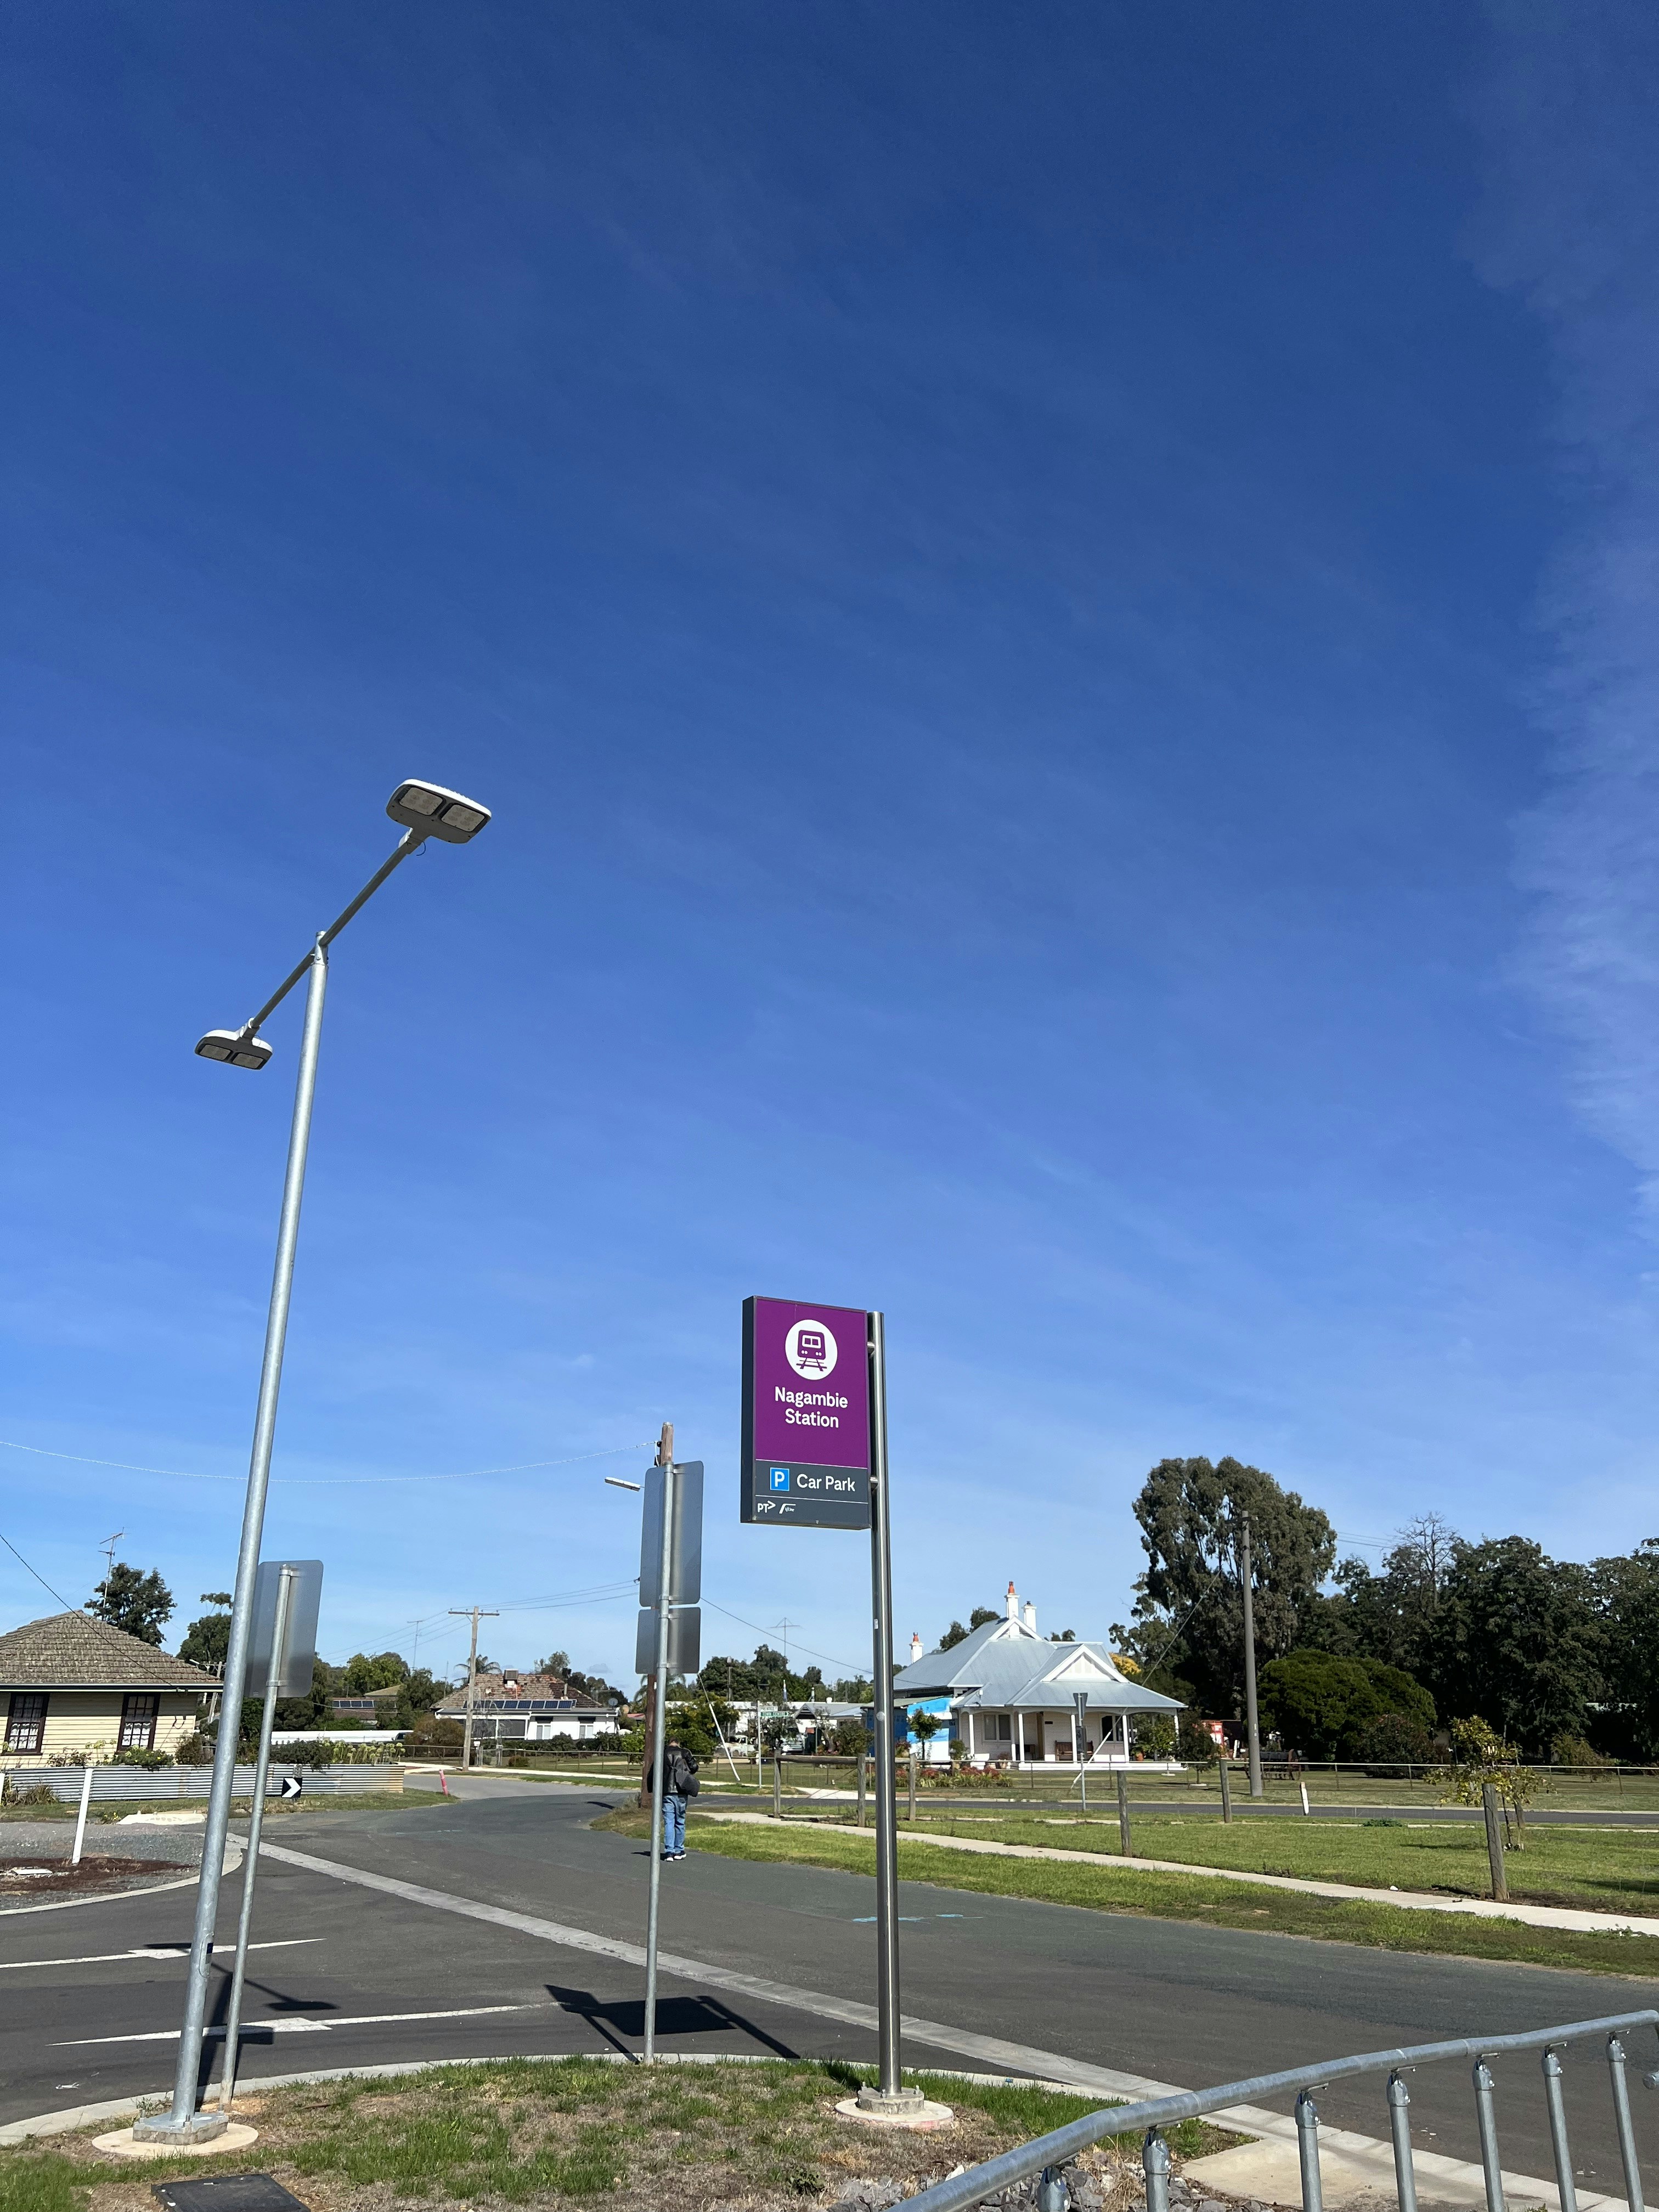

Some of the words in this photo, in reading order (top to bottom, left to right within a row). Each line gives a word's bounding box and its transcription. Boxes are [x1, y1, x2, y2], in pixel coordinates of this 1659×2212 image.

[775, 1386, 848, 1408] Nagambie
[785, 1408, 839, 1428] Station
[774, 1471, 785, 1487] P
[797, 1474, 822, 1489] Car
[825, 1475, 856, 1492] Park
